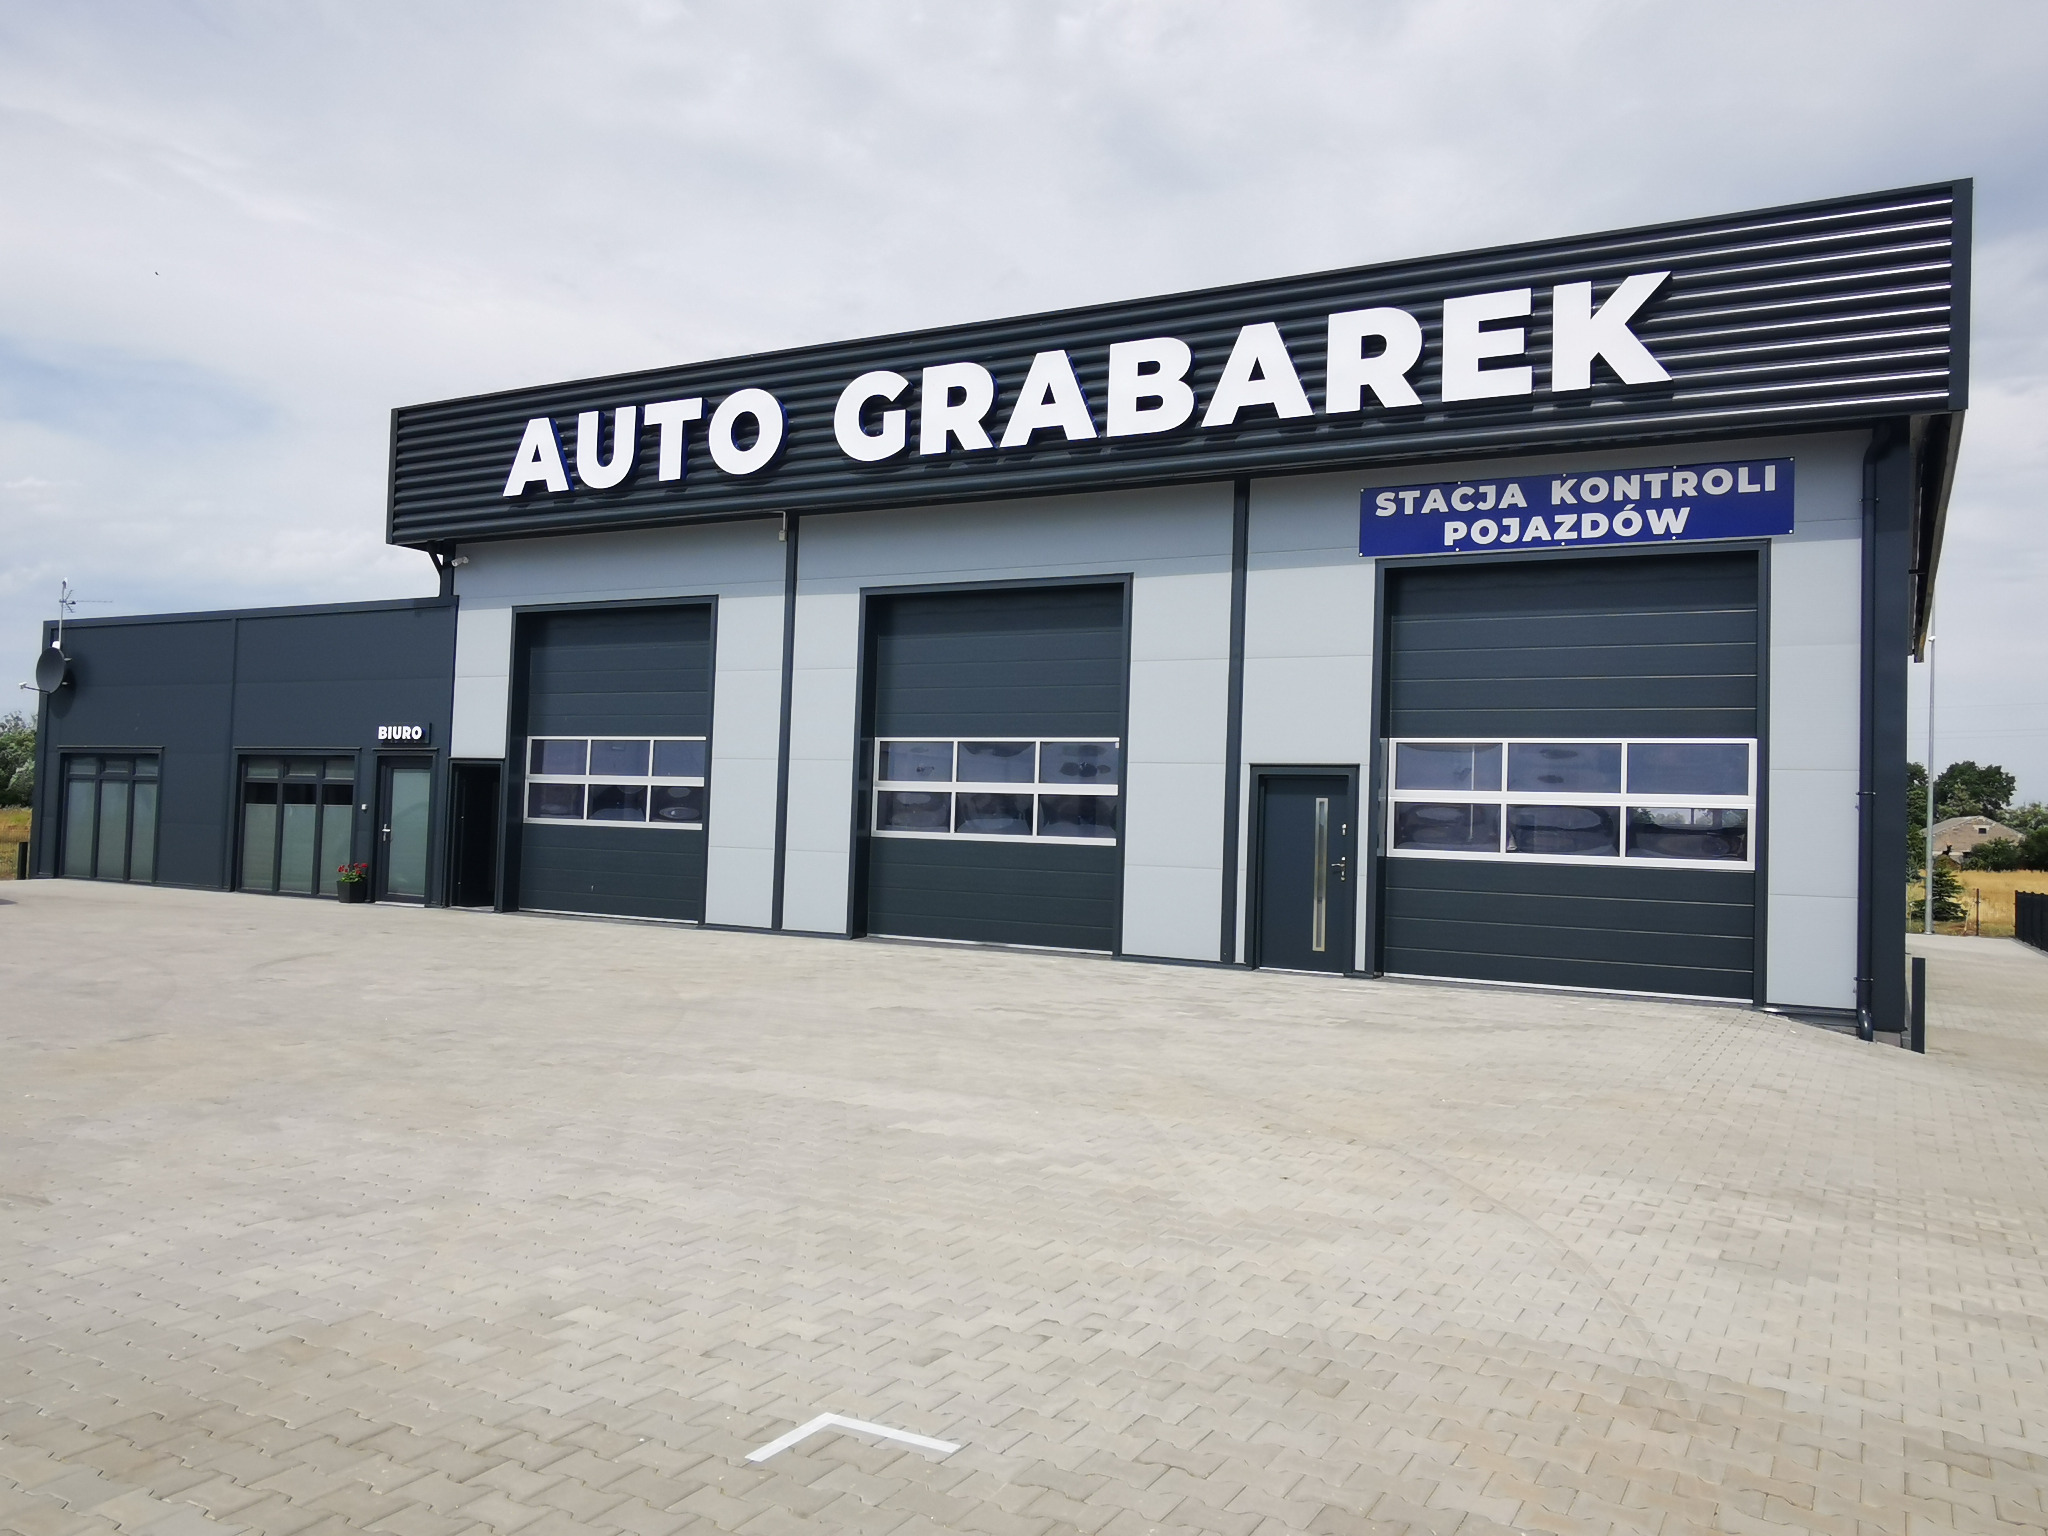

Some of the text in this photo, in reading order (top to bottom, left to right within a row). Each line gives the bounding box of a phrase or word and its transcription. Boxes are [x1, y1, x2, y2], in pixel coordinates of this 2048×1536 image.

[502, 270, 1674, 498] AUTO GRABAREK
[1375, 465, 1776, 517] STACJA KONTROLI
[1444, 505, 1690, 546] POJAZDÓW
[377, 725, 423, 740] BIURO
